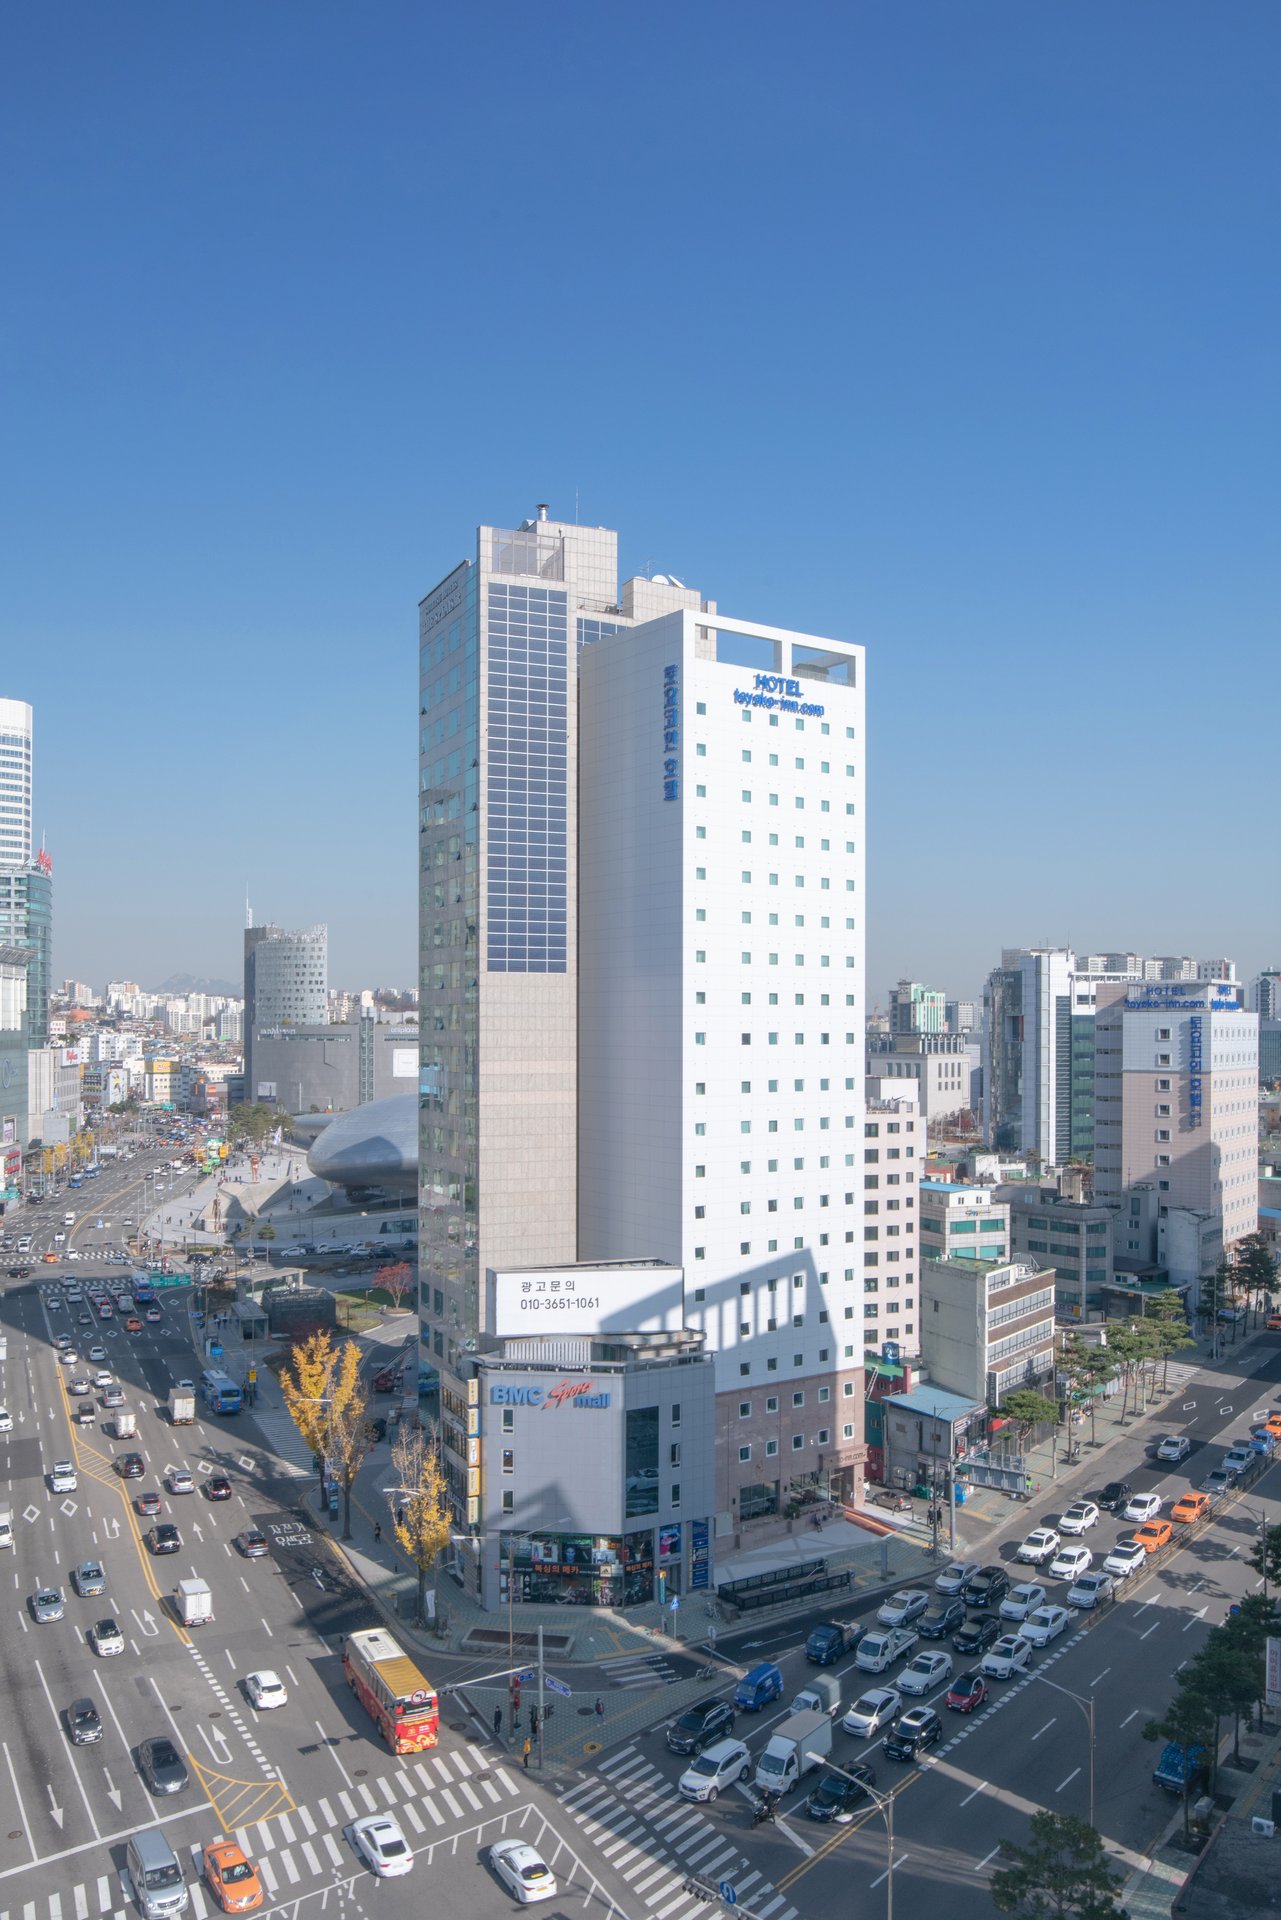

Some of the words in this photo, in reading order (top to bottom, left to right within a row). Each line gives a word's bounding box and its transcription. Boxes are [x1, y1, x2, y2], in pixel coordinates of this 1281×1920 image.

[754, 673, 804, 699] HOTEL
[733, 687, 825, 718] toyoko-inn.com
[1145, 986, 1186, 996] HOTEL
[1125, 998, 1205, 1009] toyoko-inn.com
[520, 1297, 599, 1310] 010-3651-1061
[491, 1385, 544, 1406] BMC
[574, 1392, 611, 1408] mall
[267, 1522, 307, 1535] 자전거
